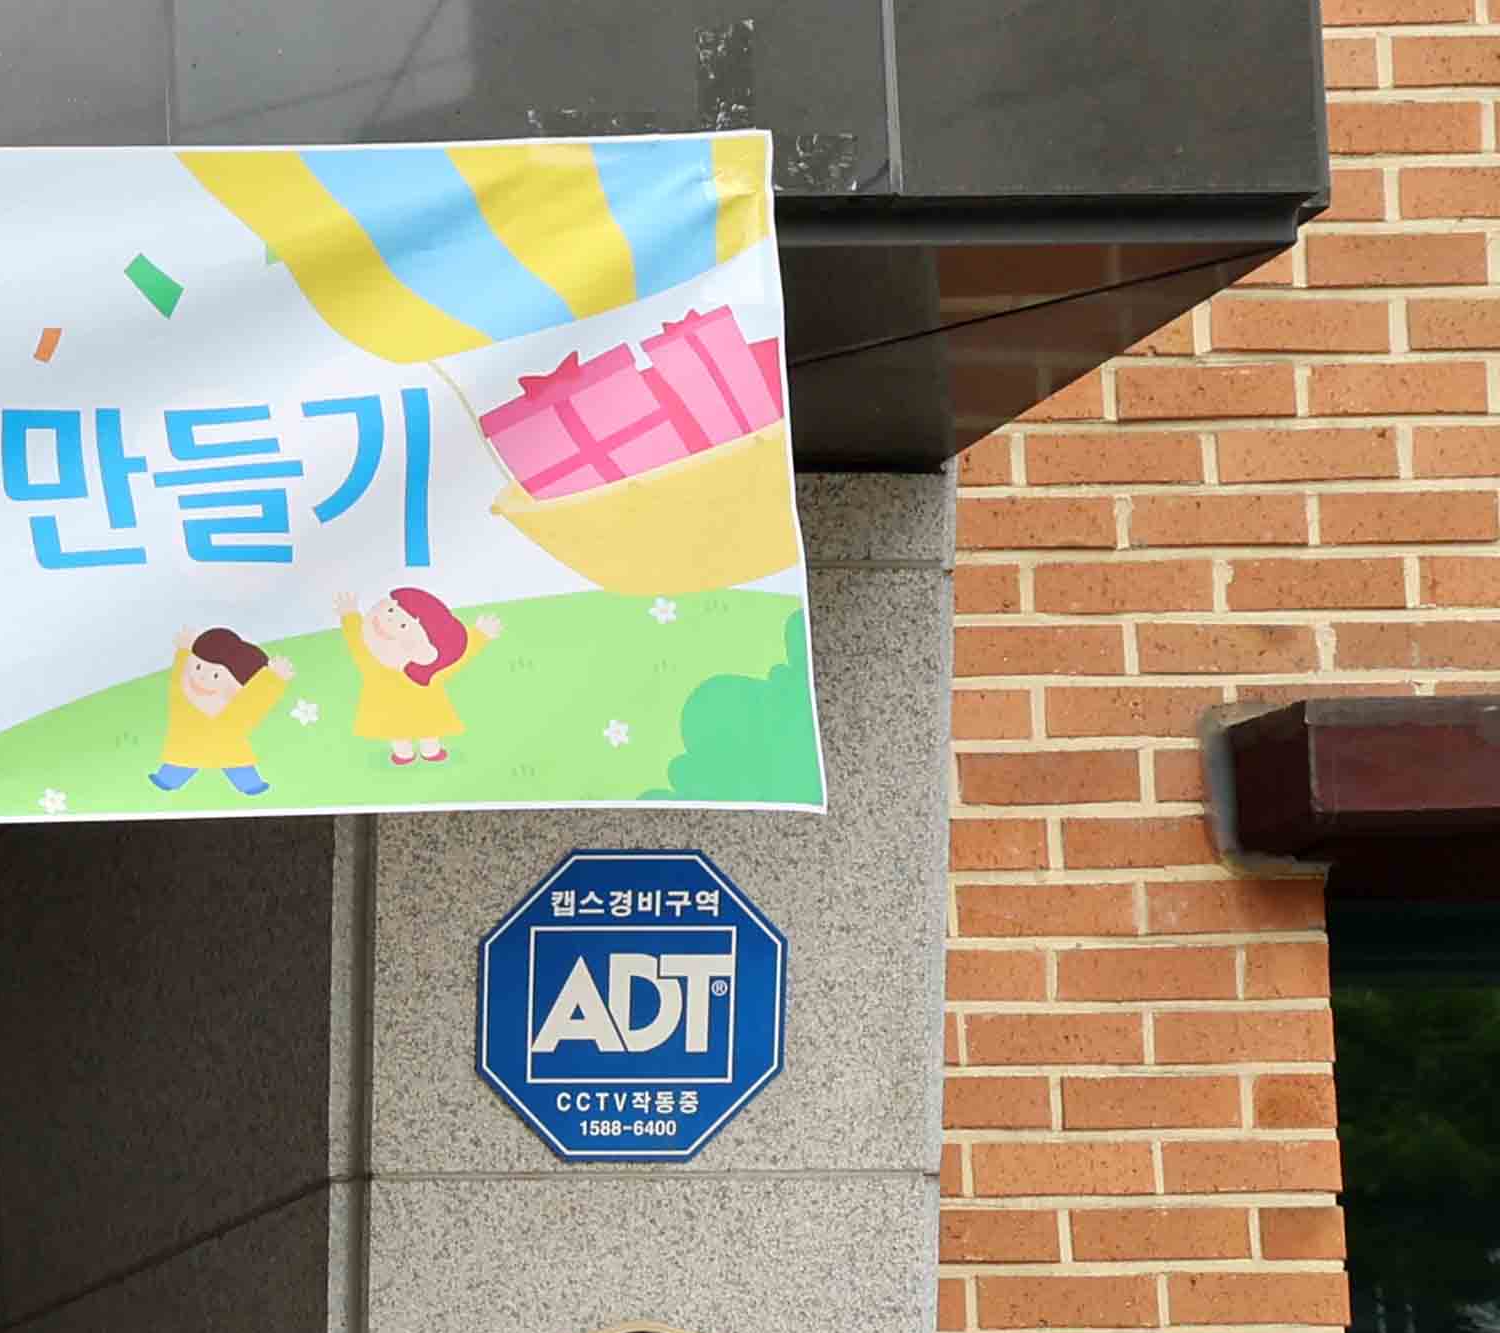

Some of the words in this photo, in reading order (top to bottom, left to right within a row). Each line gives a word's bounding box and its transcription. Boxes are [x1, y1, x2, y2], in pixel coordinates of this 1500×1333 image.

[2, 388, 430, 569] 만들기
[549, 888, 722, 919] 캡스경비구역
[532, 954, 732, 1052] ADT
[556, 1090, 700, 1115] CCTV작동중
[579, 1120, 677, 1137] 1588-6400
